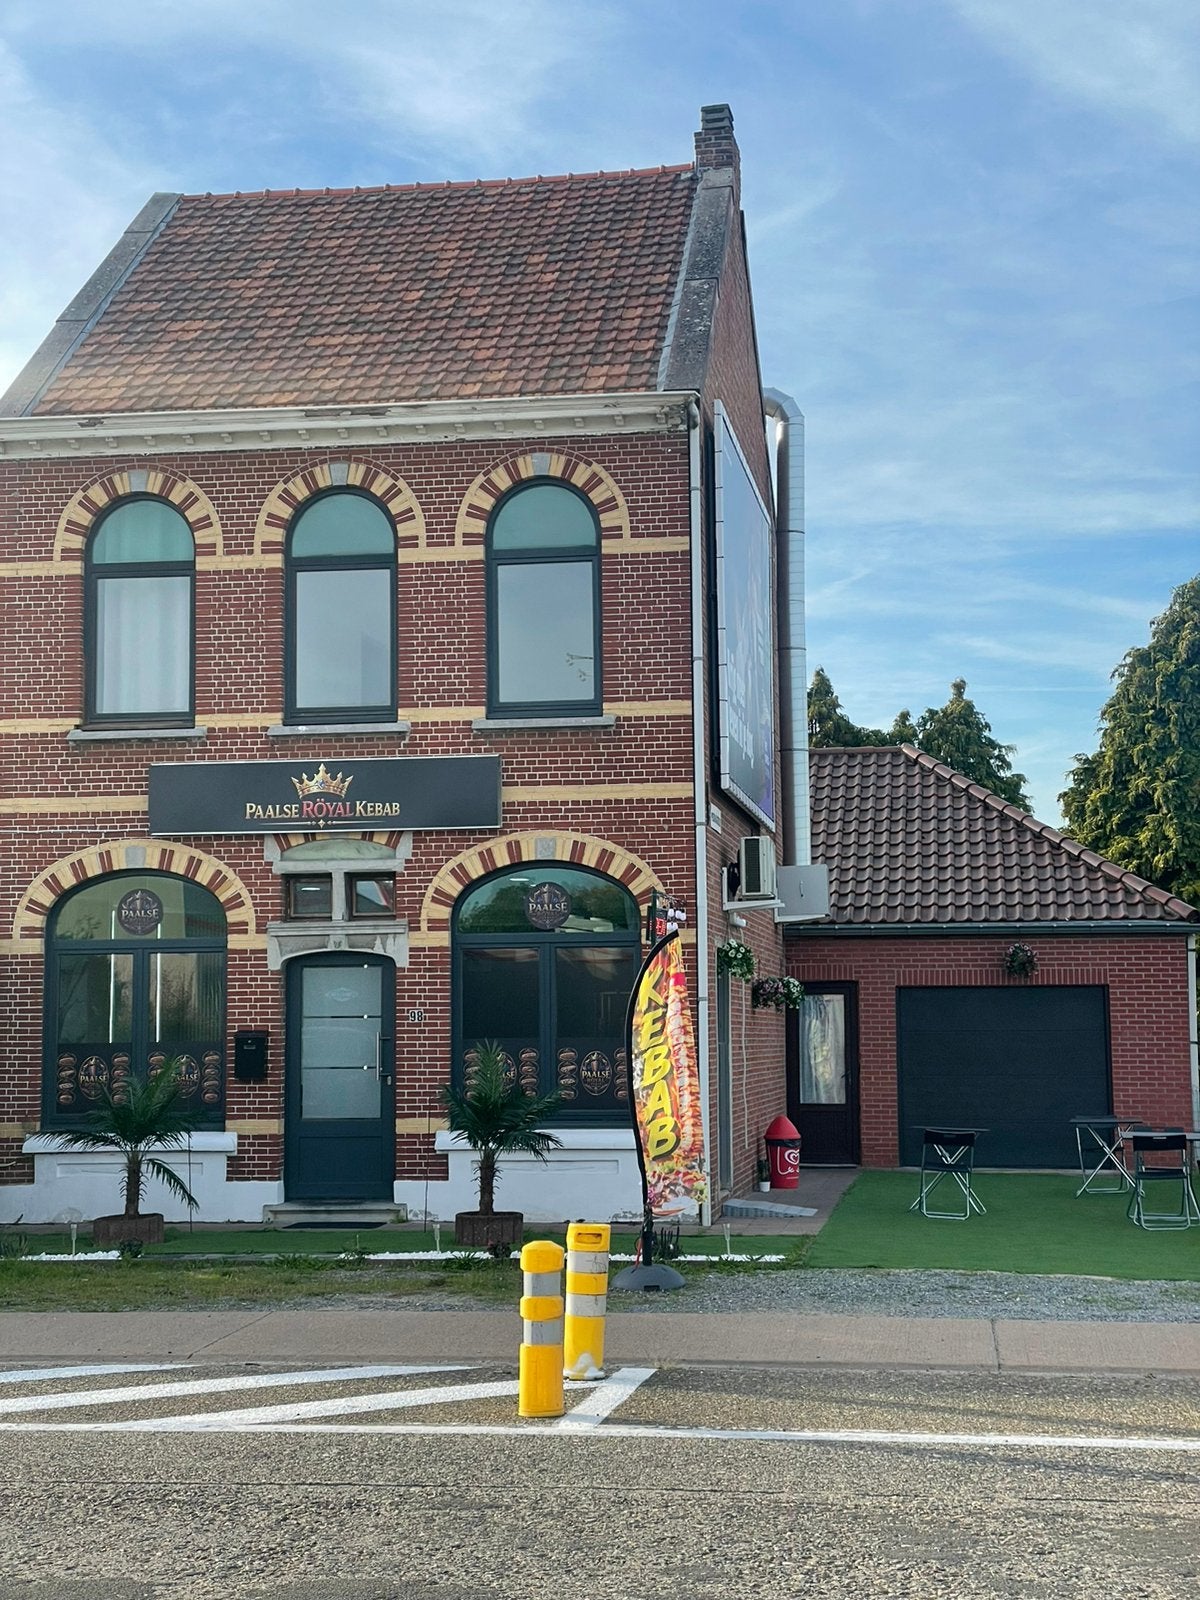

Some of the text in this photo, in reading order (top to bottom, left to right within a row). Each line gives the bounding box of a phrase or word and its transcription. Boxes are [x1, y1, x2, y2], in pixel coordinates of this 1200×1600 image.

[245, 798, 400, 819] PAALSE RÖYAL KEBAB
[528, 902, 568, 913] PAALSE
[121, 908, 159, 920] PAALSE
[409, 1010, 424, 1022] 98
[637, 966, 680, 1159] KEBAB
[581, 1070, 611, 1079] PAALSE
